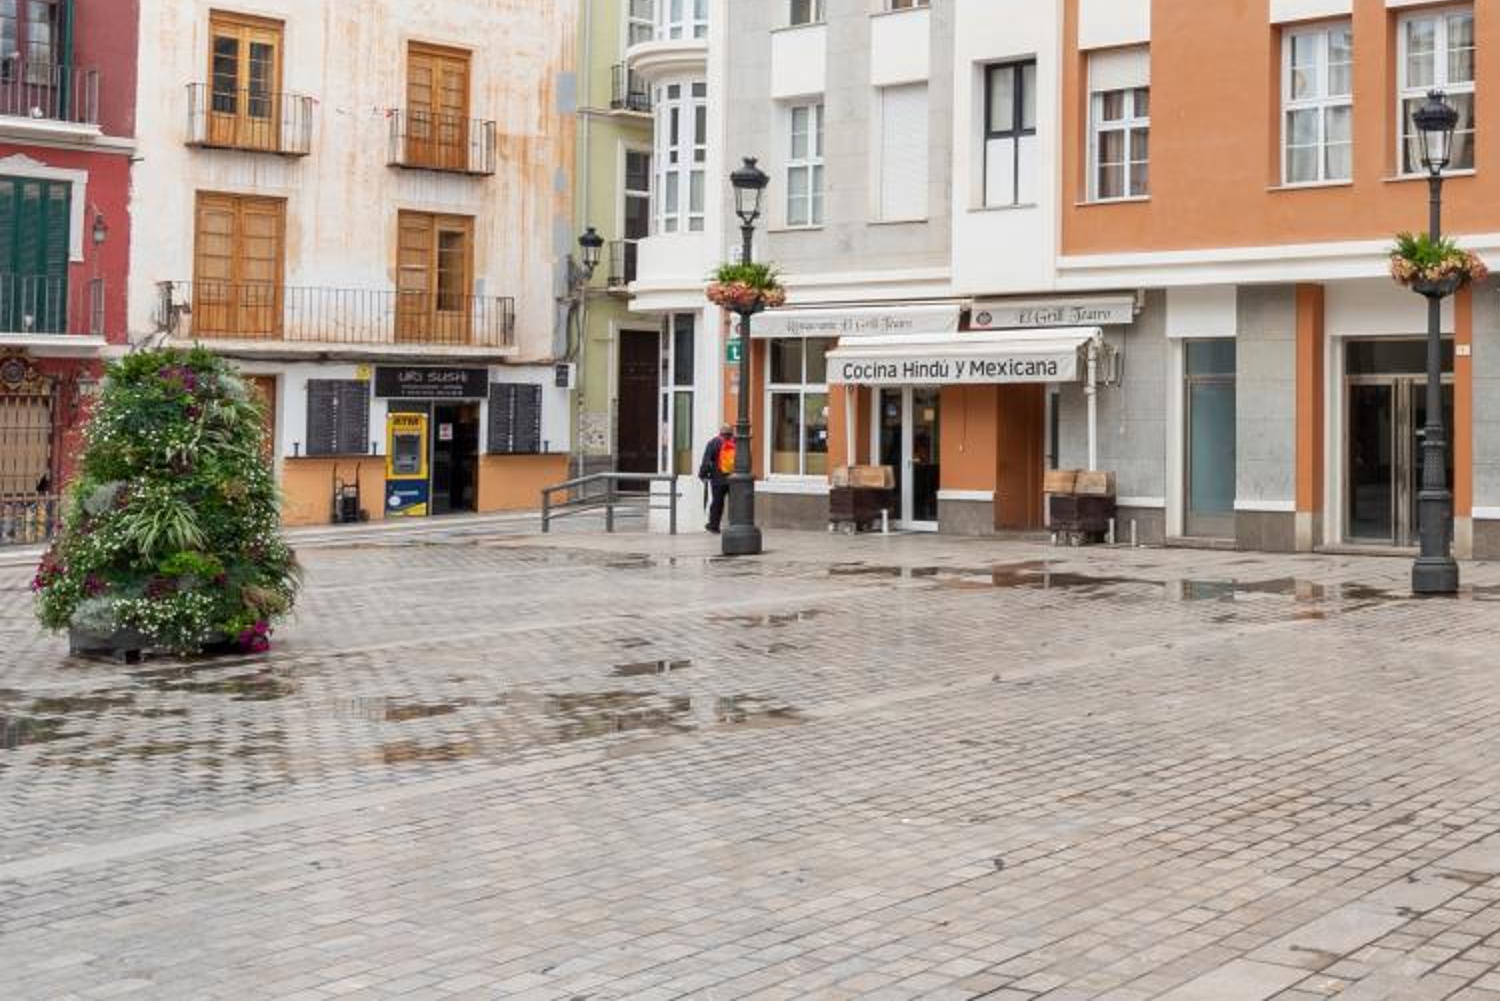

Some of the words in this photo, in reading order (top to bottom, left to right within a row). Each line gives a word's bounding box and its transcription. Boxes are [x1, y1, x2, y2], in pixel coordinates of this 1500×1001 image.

[843, 362, 897, 379] Cocina
[903, 360, 949, 378] Hindú
[969, 359, 1058, 377] Mexicana
